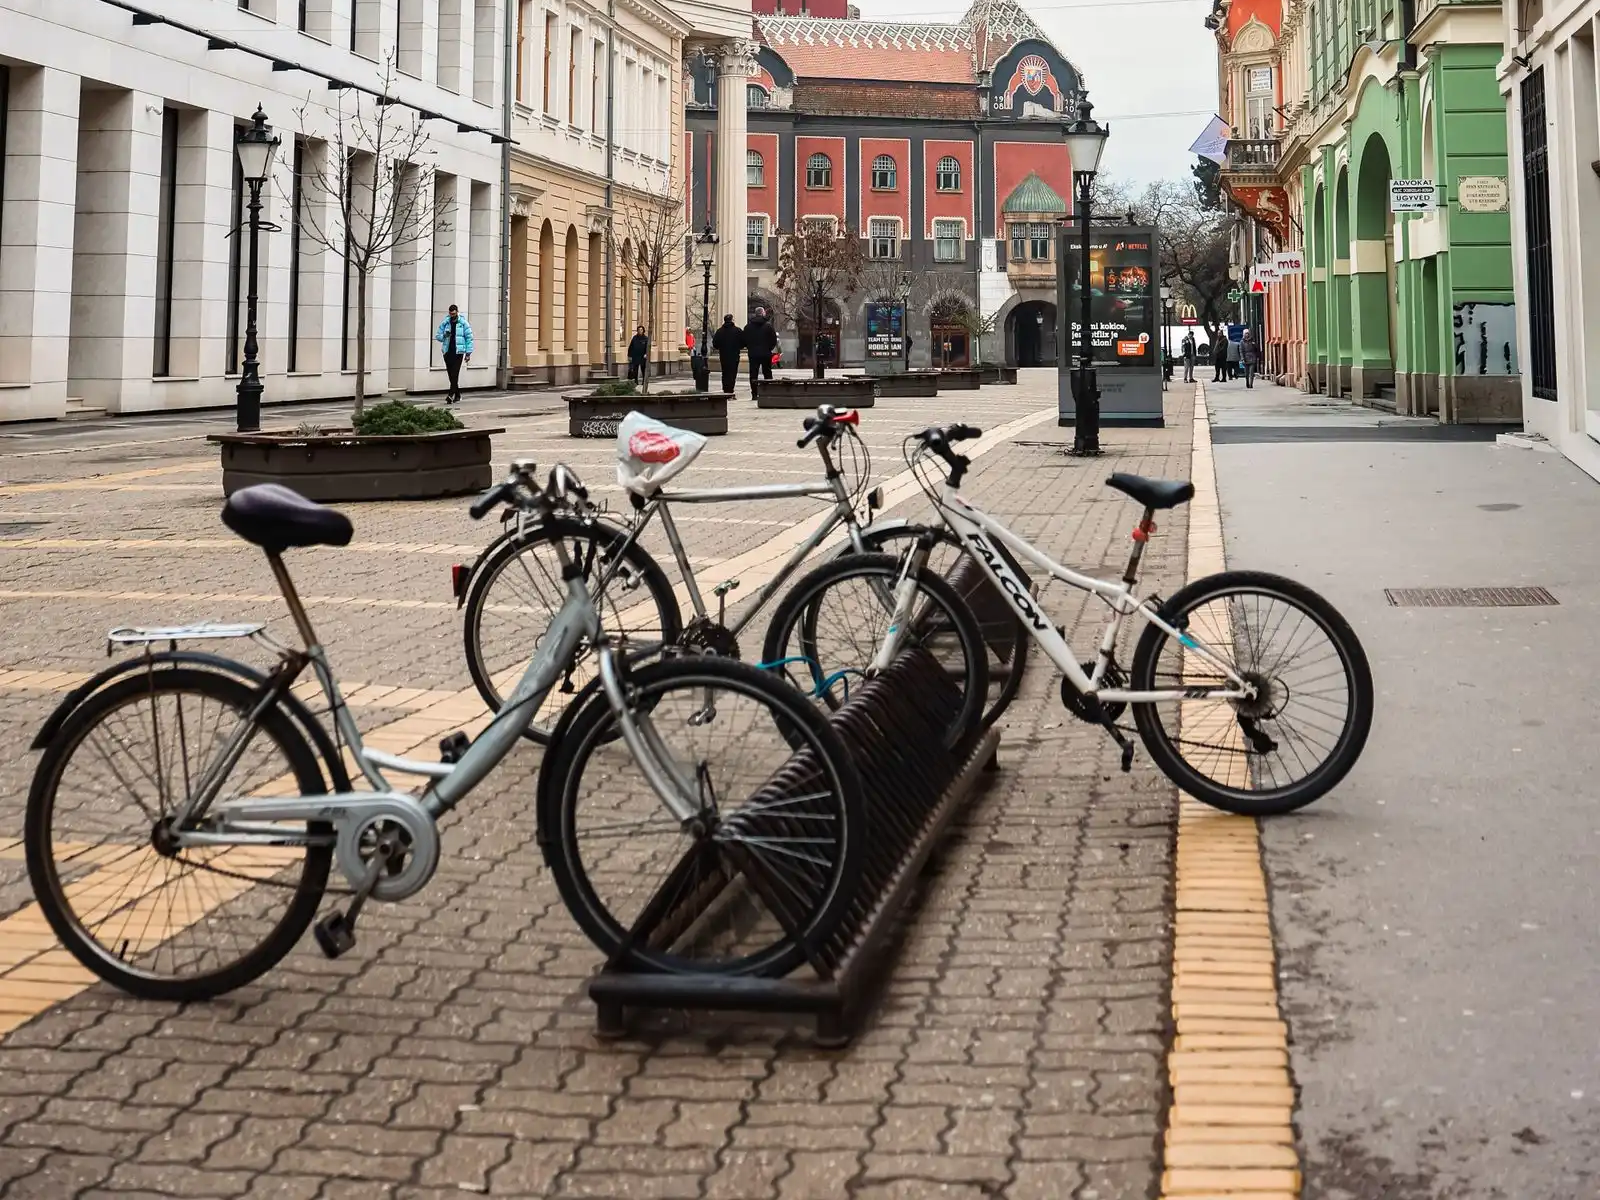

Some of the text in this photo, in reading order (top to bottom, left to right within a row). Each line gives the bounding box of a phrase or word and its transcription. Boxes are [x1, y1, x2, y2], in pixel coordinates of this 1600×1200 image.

[1278, 259, 1300, 269] mts
[1100, 322, 1126, 330] kokice,
[1110, 331, 1118, 339] je
[966, 534, 1048, 630] FALCON
